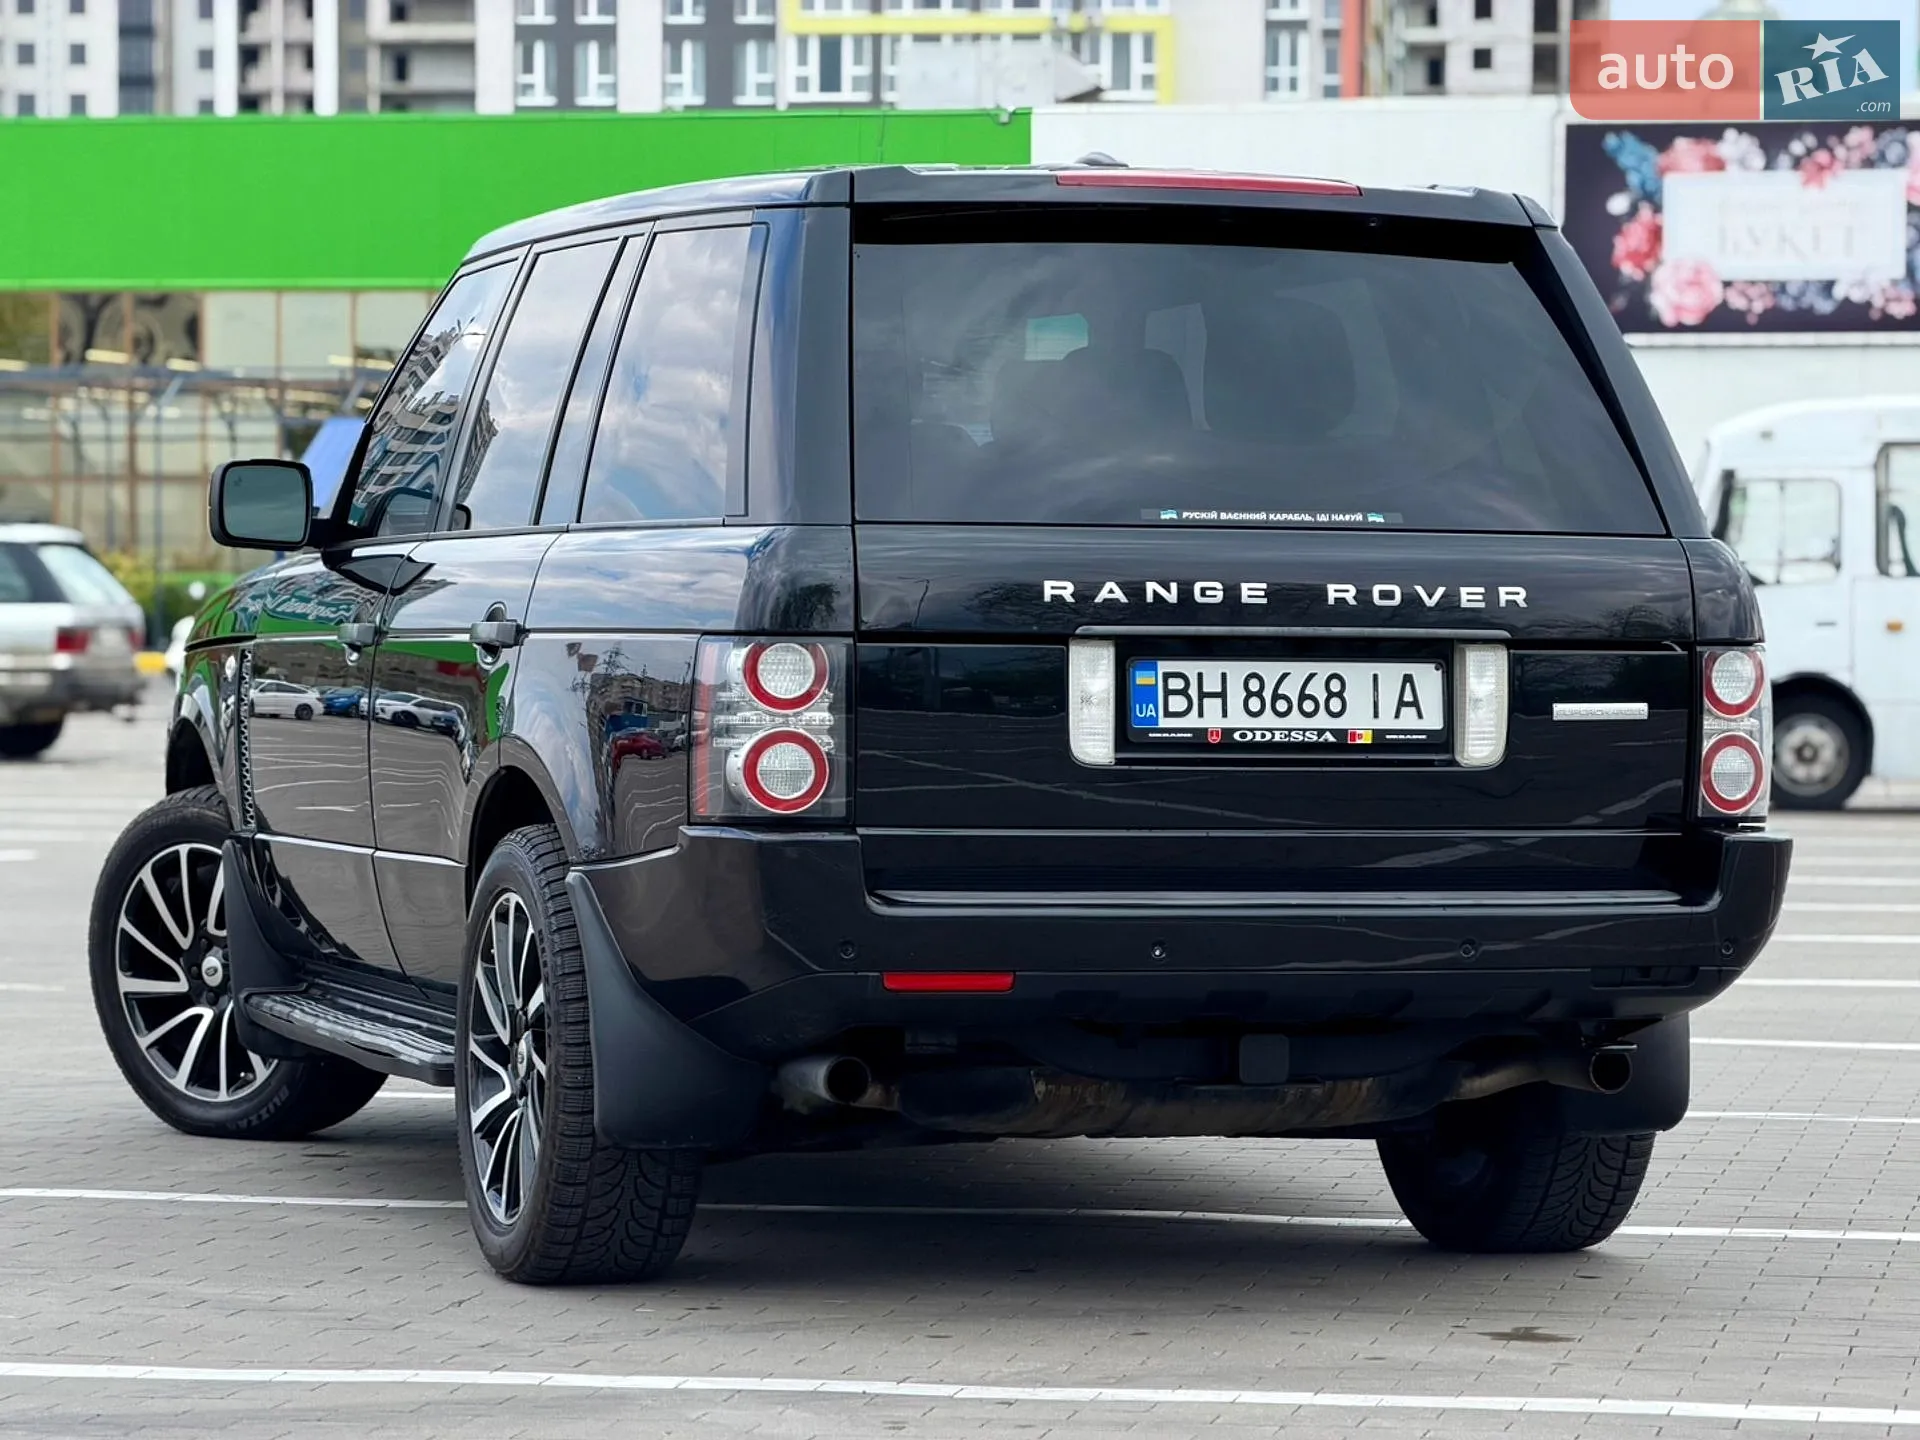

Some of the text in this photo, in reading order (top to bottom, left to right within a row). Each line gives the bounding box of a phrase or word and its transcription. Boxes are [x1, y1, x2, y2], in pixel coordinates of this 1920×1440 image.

[1043, 580, 1528, 608] RANGE ROVER
[1162, 671, 1424, 720] BH 8668 IA
[1136, 703, 1156, 718] UA
[1233, 730, 1337, 742] ODESSA
